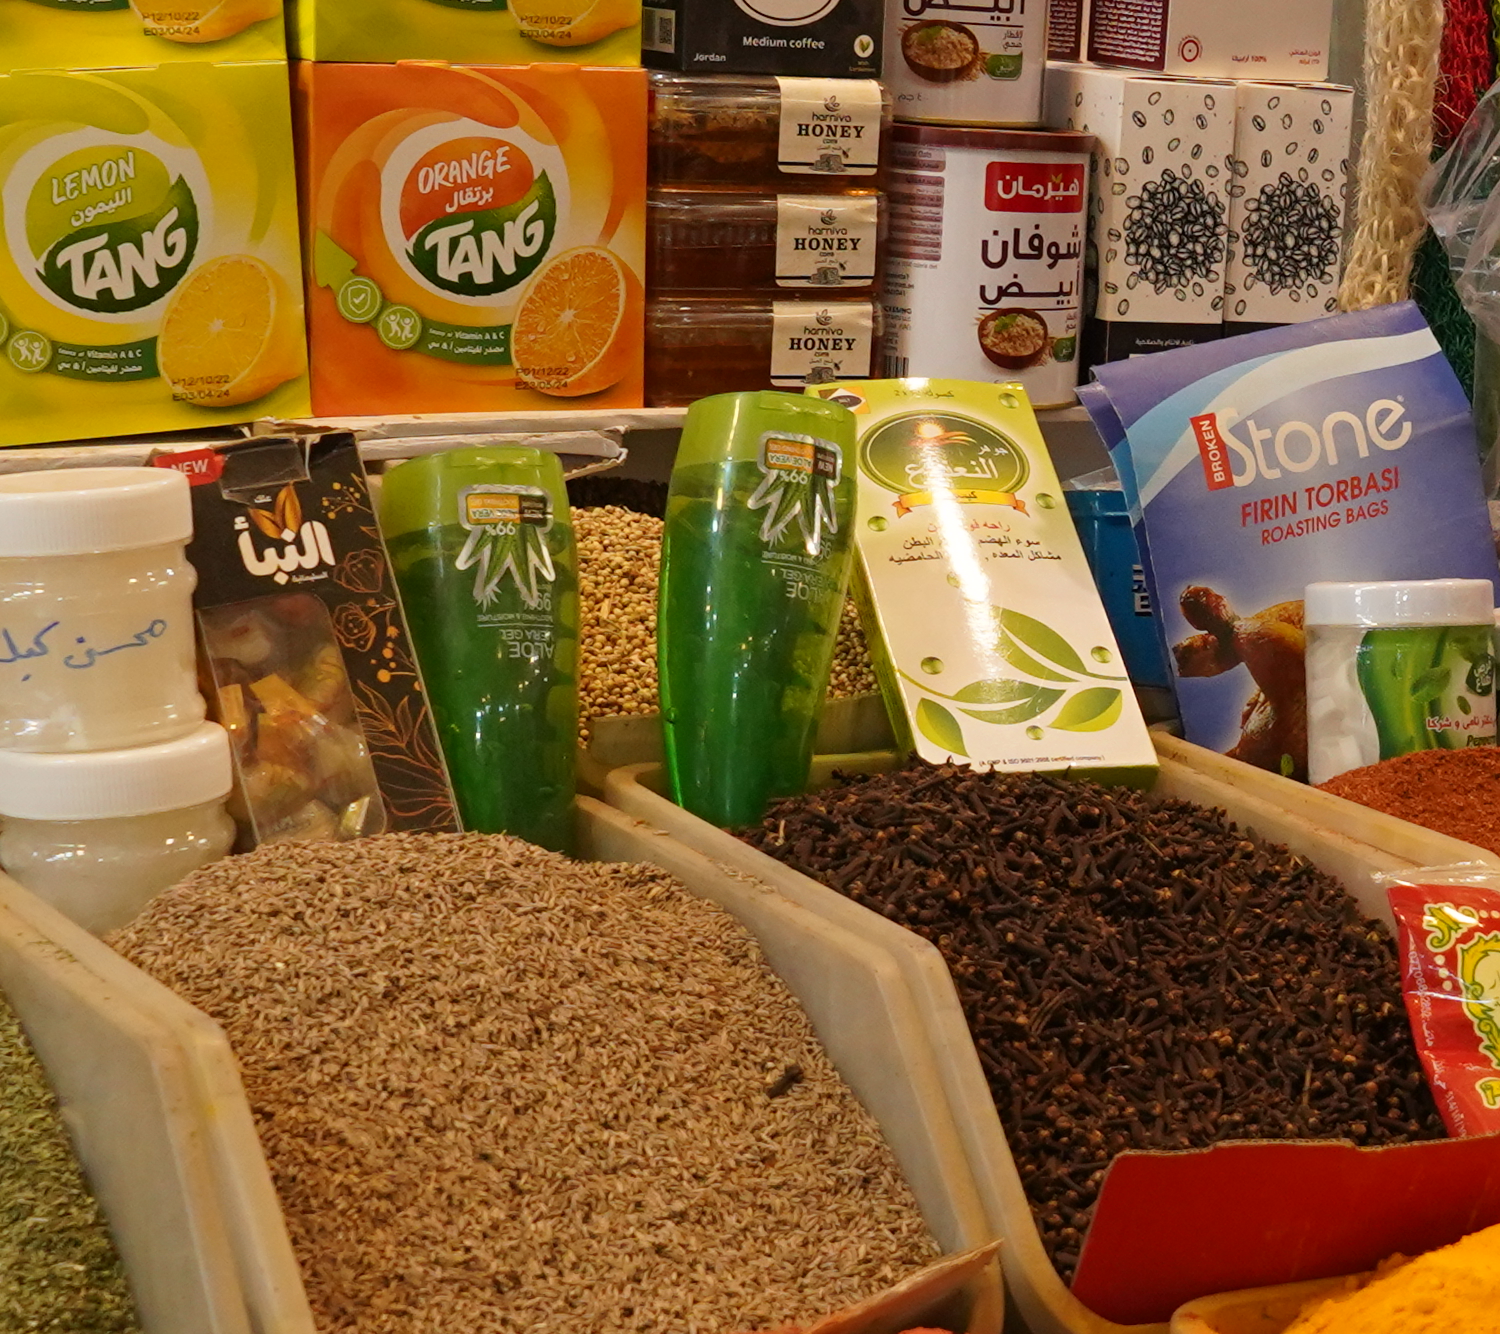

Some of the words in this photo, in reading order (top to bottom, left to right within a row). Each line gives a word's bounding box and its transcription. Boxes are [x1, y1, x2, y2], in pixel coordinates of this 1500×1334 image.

[693, 52, 727, 63] Jordan
[742, 34, 786, 49] Medium
[791, 37, 826, 51] coffee
[796, 123, 865, 139] HONEY
[50, 151, 136, 205] LEMON
[417, 145, 512, 195] ORANGE
[70, 187, 133, 227] الليمون
[445, 186, 495, 213] برتقال
[56, 206, 187, 301] TANG
[423, 199, 546, 285] TANG
[794, 237, 861, 251] HONEY
[981, 223, 1082, 268] شوفان
[788, 337, 857, 351] HONEY
[1201, 419, 1226, 485] BROKEN
[1217, 398, 1413, 488] Stone
[779, 469, 809, 485] 99%
[1240, 487, 1300, 528] FIRIN
[1304, 466, 1401, 511] TORBASI
[486, 522, 516, 536] 99%
[1260, 513, 1342, 546] ROASTING
[1345, 499, 1390, 525] BAGS
[499, 628, 524, 641] GEL
[507, 640, 554, 659] ALOE
